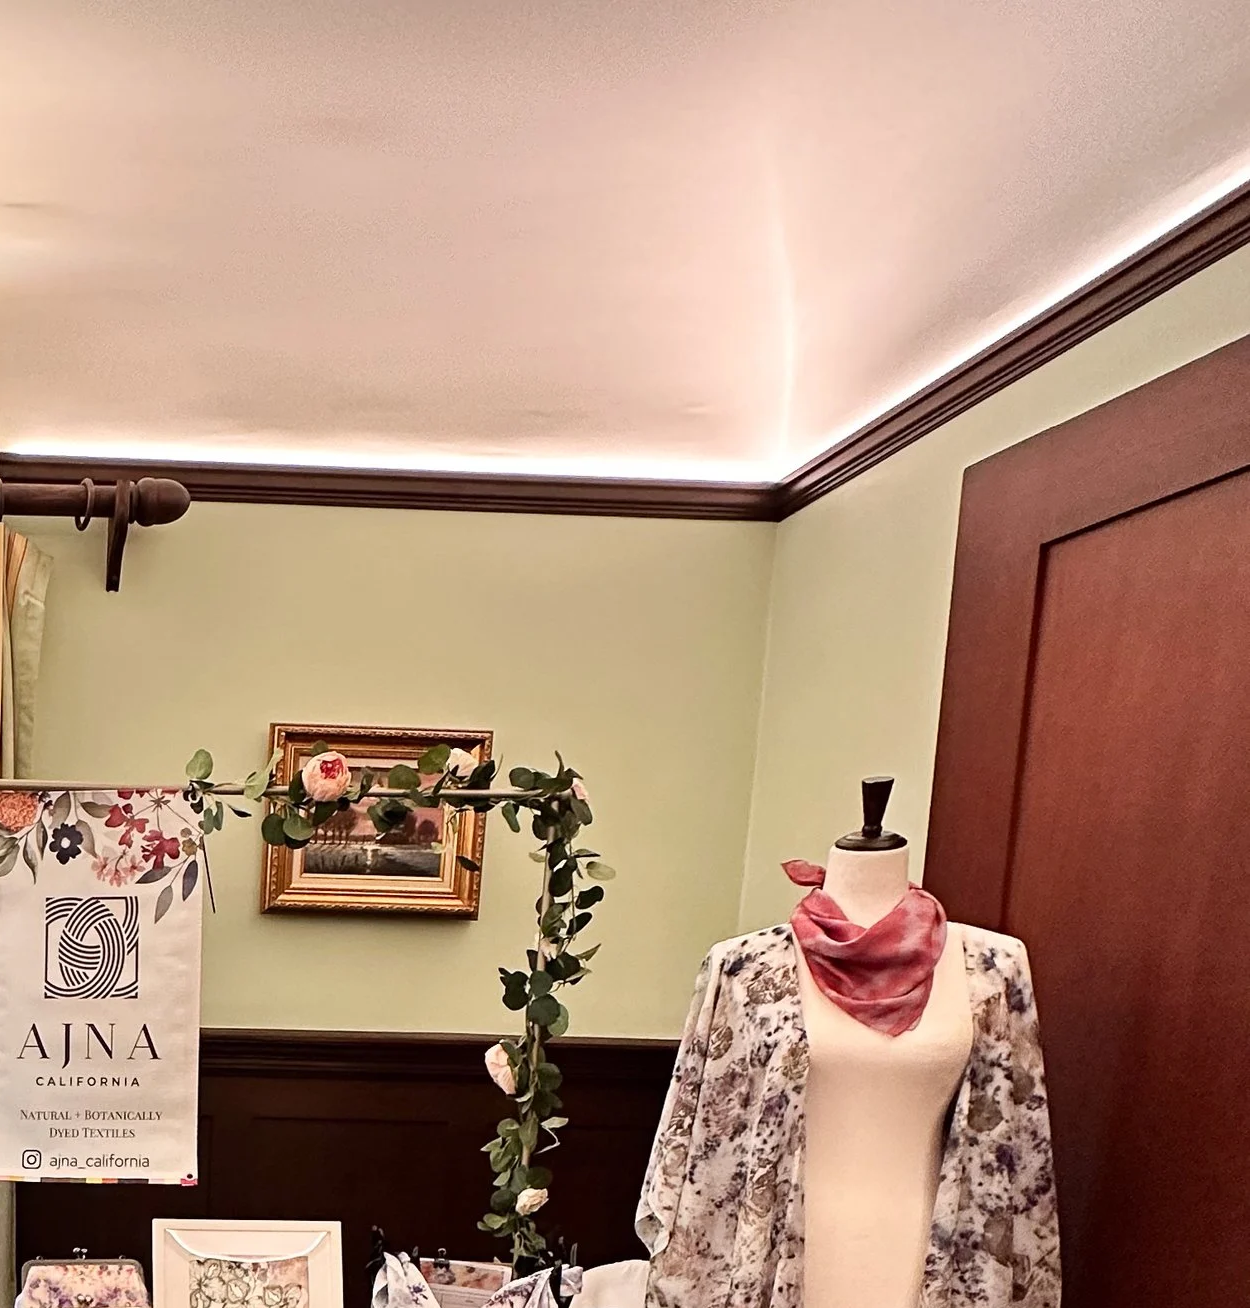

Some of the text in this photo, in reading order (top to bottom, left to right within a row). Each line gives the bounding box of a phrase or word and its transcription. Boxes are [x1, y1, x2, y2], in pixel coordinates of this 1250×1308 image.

[16, 1023, 162, 1069] AJNA
[36, 1076, 140, 1087] CALIFORNIA
[49, 1153, 150, 1169] ajna_california
